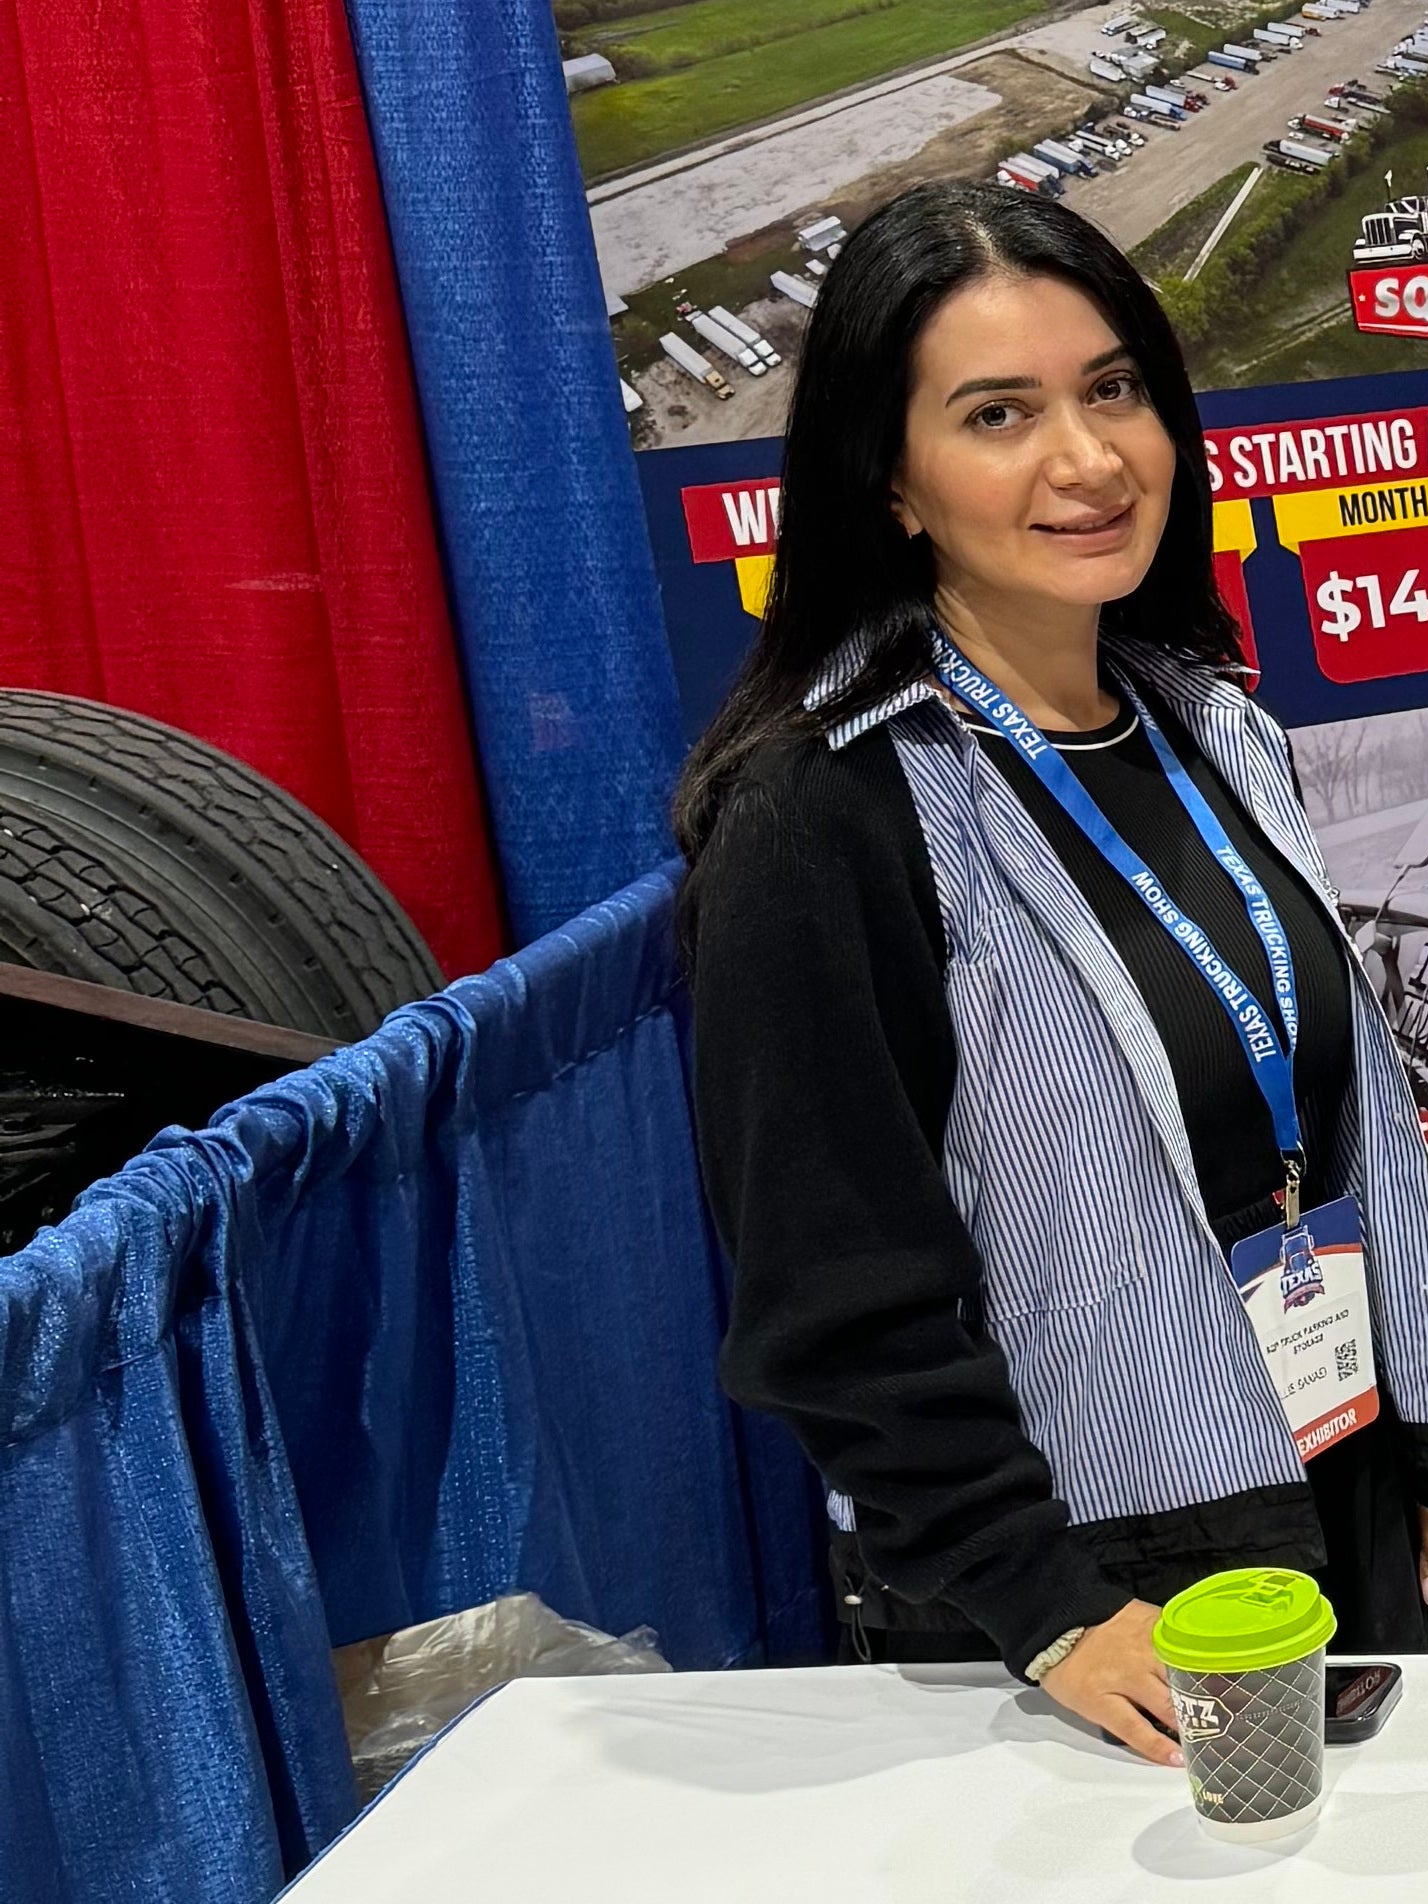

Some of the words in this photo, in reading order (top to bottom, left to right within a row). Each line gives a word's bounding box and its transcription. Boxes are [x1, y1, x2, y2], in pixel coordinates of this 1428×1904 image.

[1231, 419, 1416, 487] STARTING
[722, 487, 781, 545] W
[1339, 486, 1428, 526] MONTH
[991, 702, 1048, 761] TEXAS
[1131, 871, 1179, 924] SHOW
[1215, 845, 1262, 895] TEXAS
[1251, 898, 1291, 994] TRUCKING
[1173, 922, 1249, 1012] TRUCKING
[1238, 1007, 1277, 1063] TEXAS
[1280, 1261, 1324, 1296] TEXAS
[1297, 1408, 1357, 1456] EXHIBITOR
